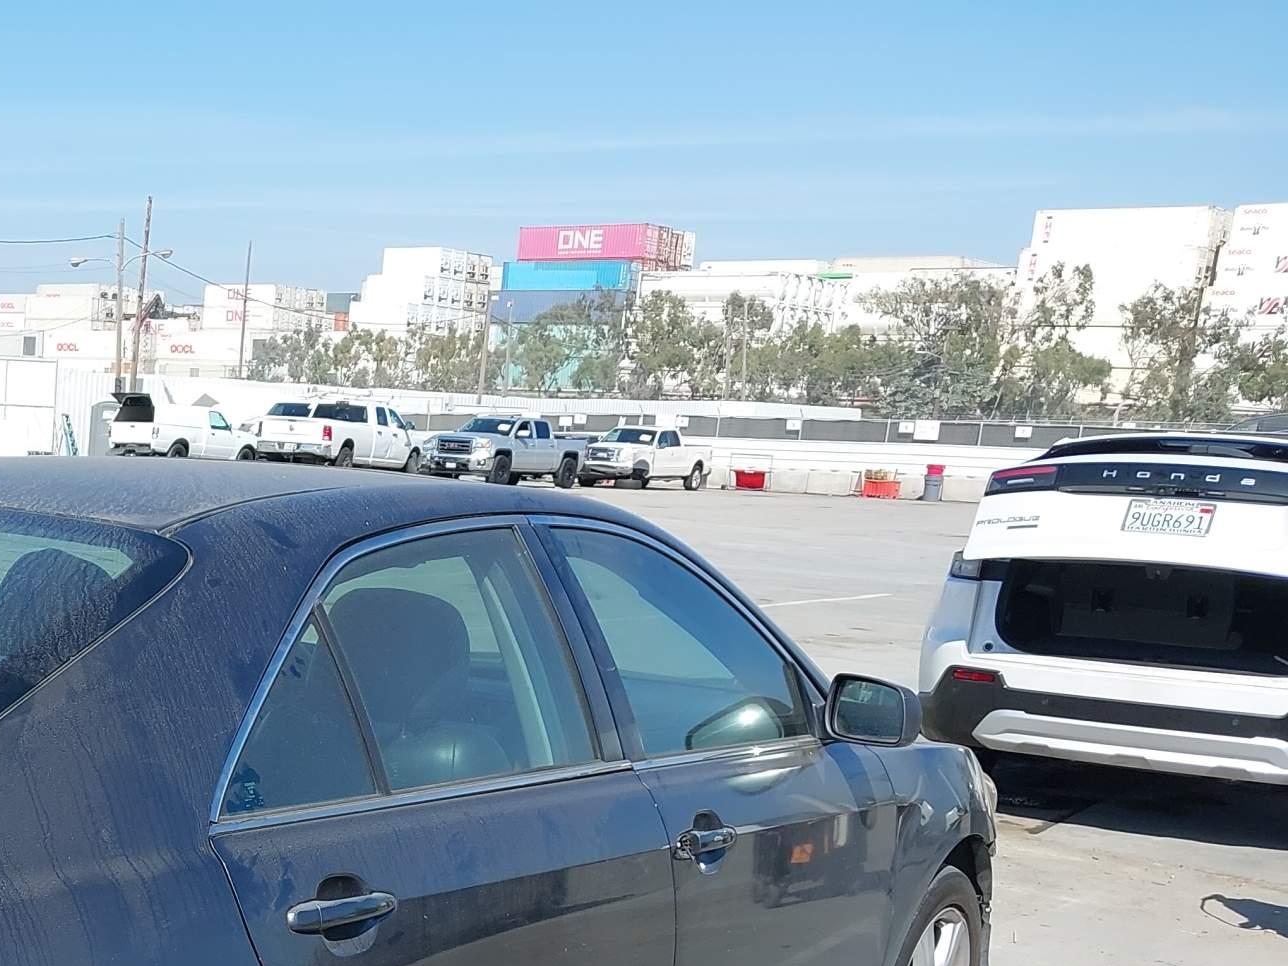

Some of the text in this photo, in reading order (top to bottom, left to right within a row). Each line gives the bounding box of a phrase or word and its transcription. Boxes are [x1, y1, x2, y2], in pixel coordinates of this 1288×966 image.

[557, 229, 603, 249] ONE
[225, 310, 250, 322] ONE
[56, 343, 79, 352] OOCL
[170, 344, 195, 353] OOCL
[1103, 469, 1256, 486] Honda
[1129, 511, 1204, 530] 9UGR691
